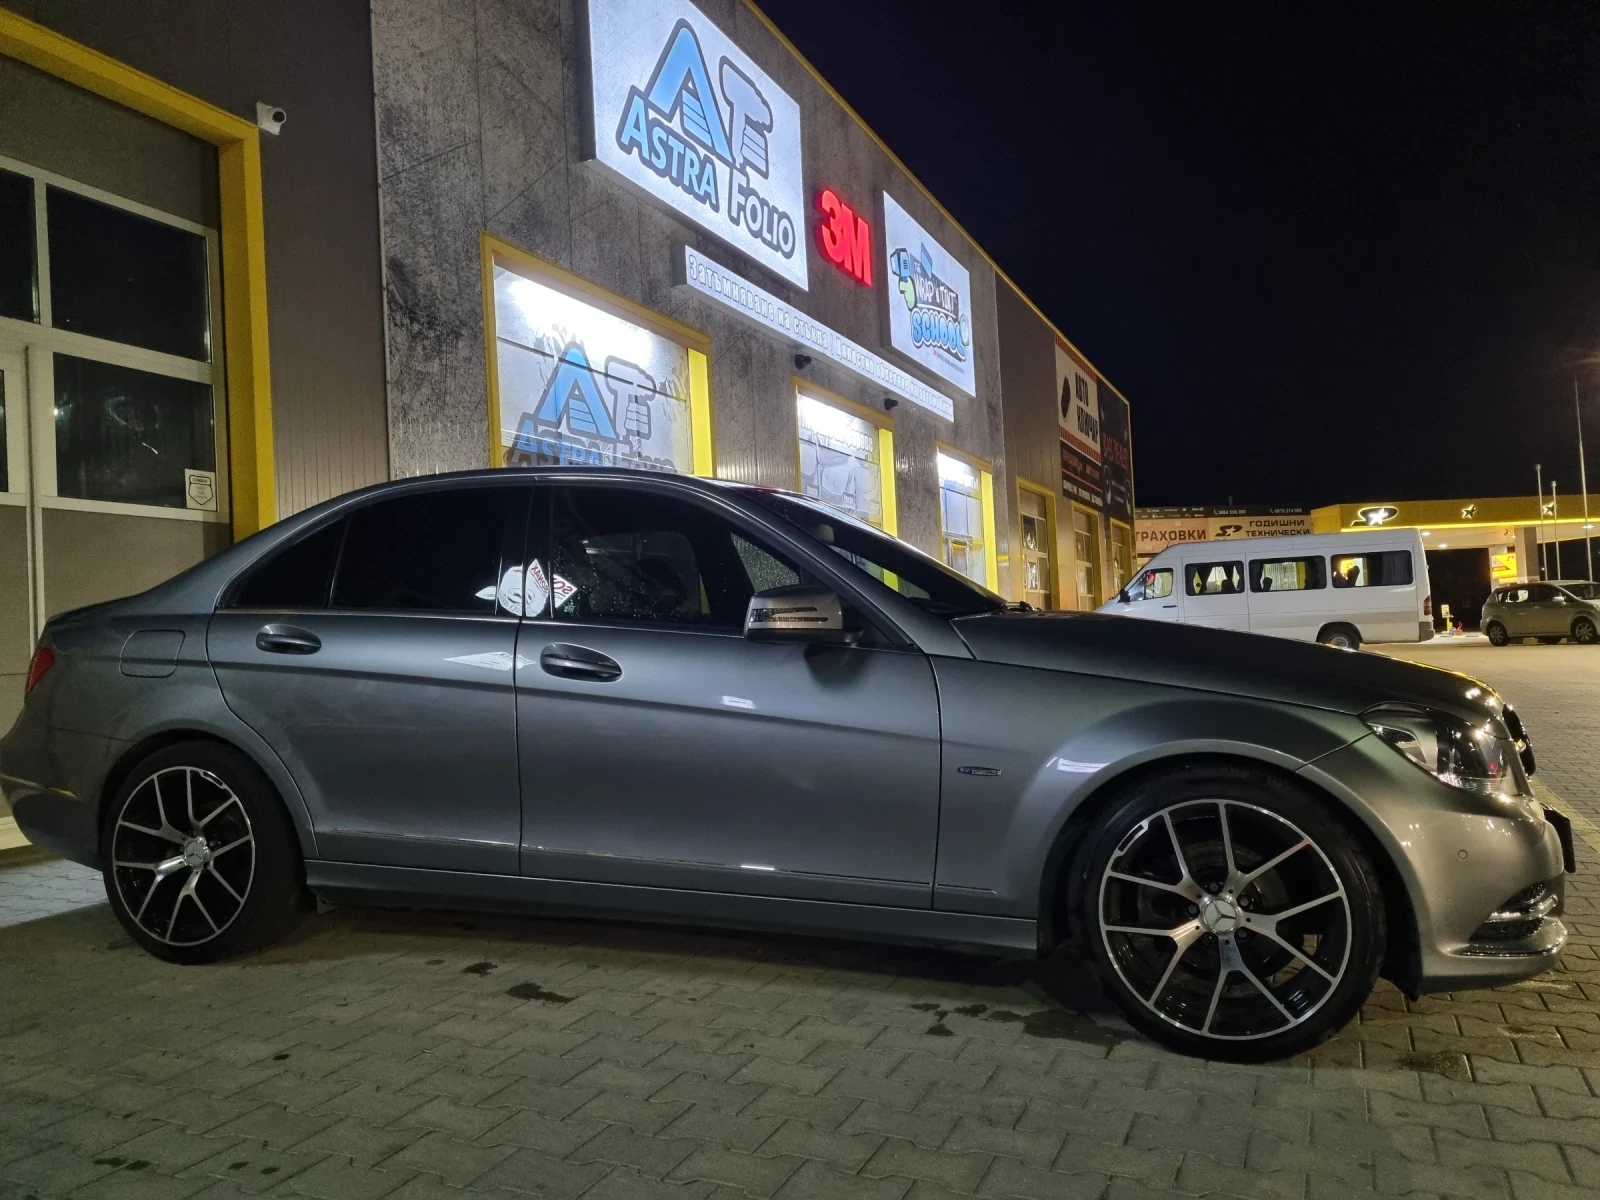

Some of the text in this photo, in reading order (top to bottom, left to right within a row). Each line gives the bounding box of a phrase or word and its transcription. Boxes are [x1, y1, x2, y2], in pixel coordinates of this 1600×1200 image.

[616, 85, 796, 260] ASTRA FOLIO
[820, 189, 872, 287] 3M
[688, 254, 829, 350] Затъмняване на стъкла
[912, 274, 935, 303] WRAP
[836, 336, 874, 376] Цялостно
[911, 308, 966, 361] SCHOOL
[1245, 529, 1311, 537] ТЕХНИЧЕСКИ
[1249, 519, 1305, 528] ГОДИШНИ
